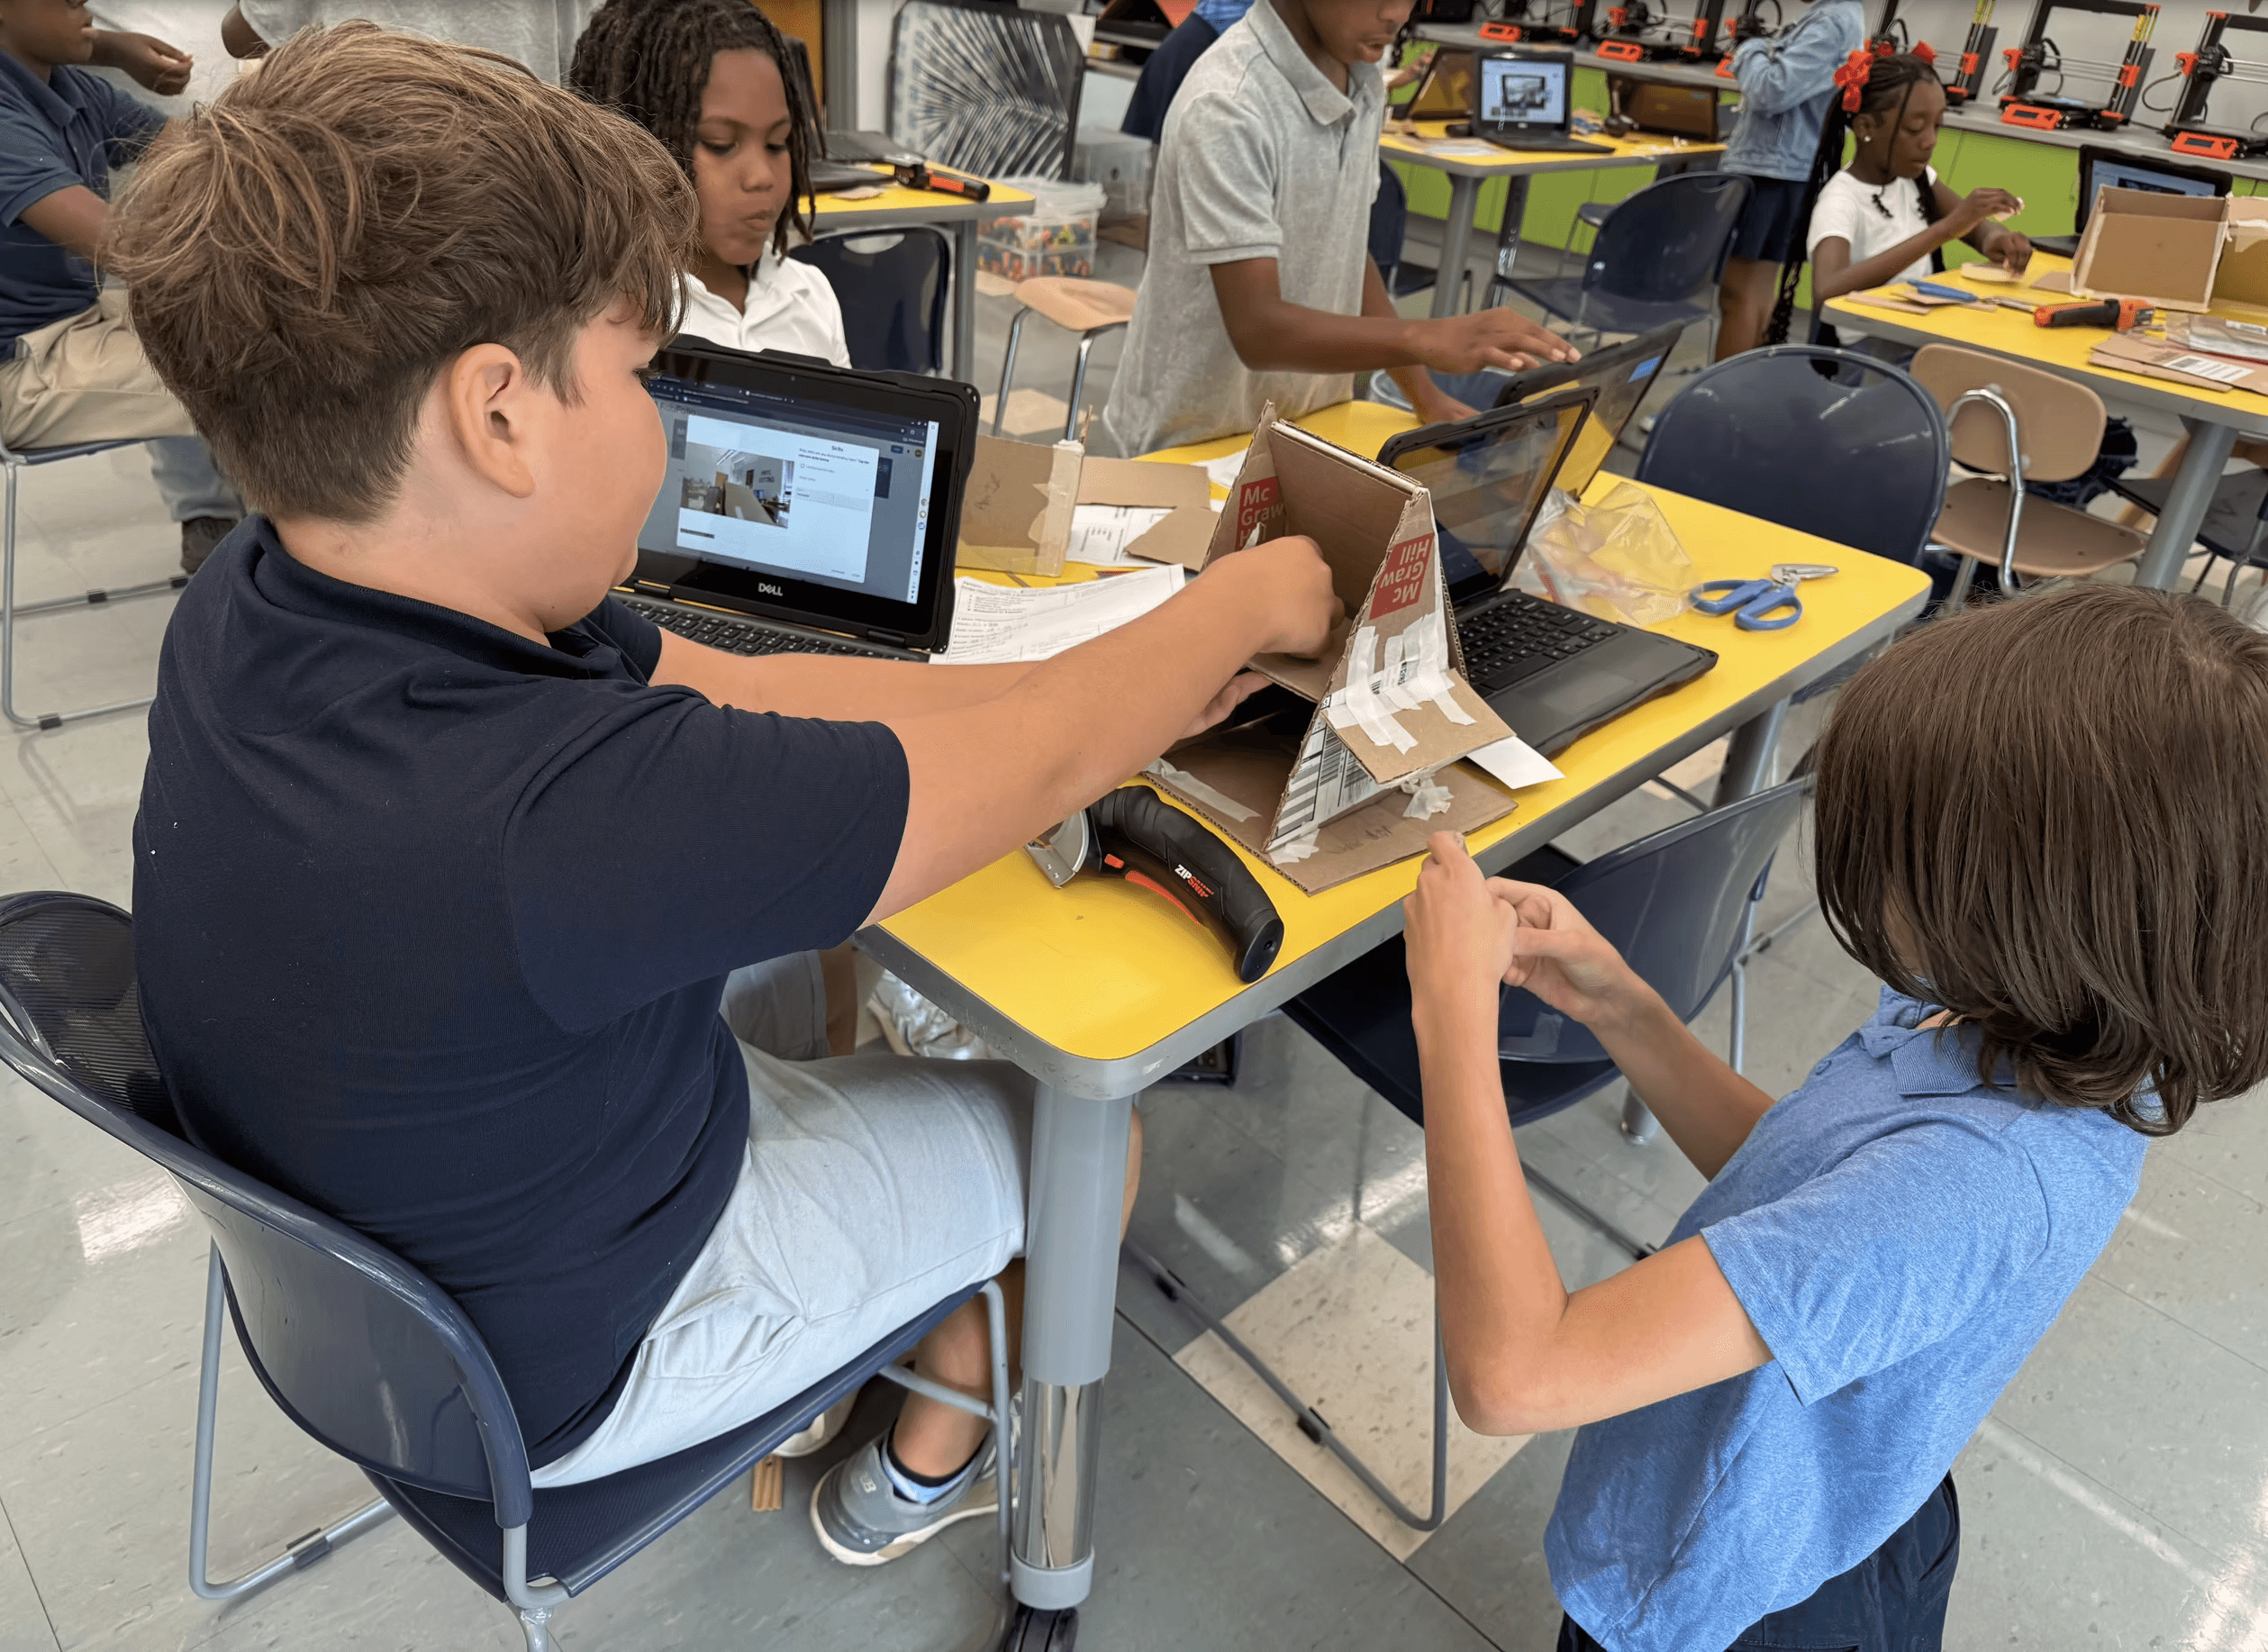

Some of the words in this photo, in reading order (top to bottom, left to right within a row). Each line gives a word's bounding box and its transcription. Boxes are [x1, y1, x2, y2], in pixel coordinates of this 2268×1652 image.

[1243, 486, 1270, 507] Mc
[1241, 504, 1284, 526] Graw
[1399, 539, 1429, 566] Hill
[1379, 560, 1425, 588] Graw
[758, 582, 784, 596] DELL
[1392, 581, 1420, 604] Mc
